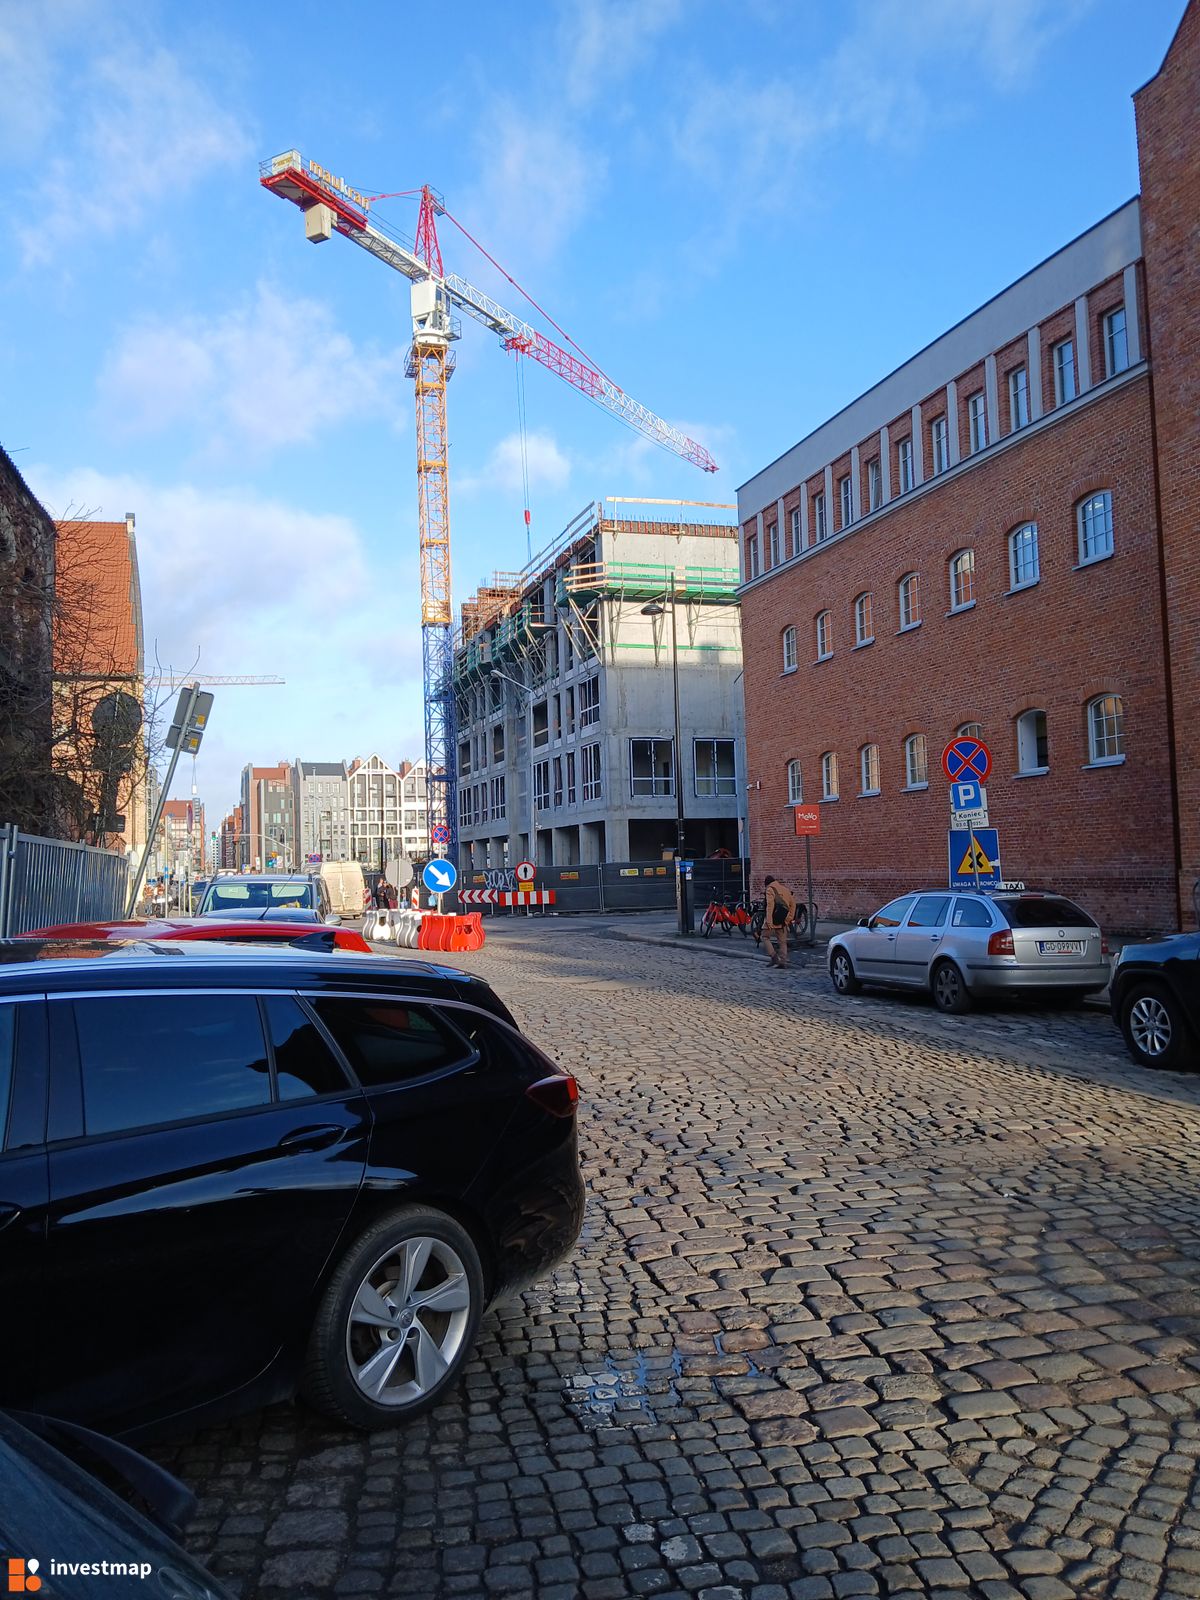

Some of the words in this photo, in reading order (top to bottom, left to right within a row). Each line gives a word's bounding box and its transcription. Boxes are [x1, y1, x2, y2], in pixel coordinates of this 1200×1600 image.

[957, 784, 975, 807] P
[958, 811, 982, 820] Koniec
[1005, 881, 1024, 890] TAXI
